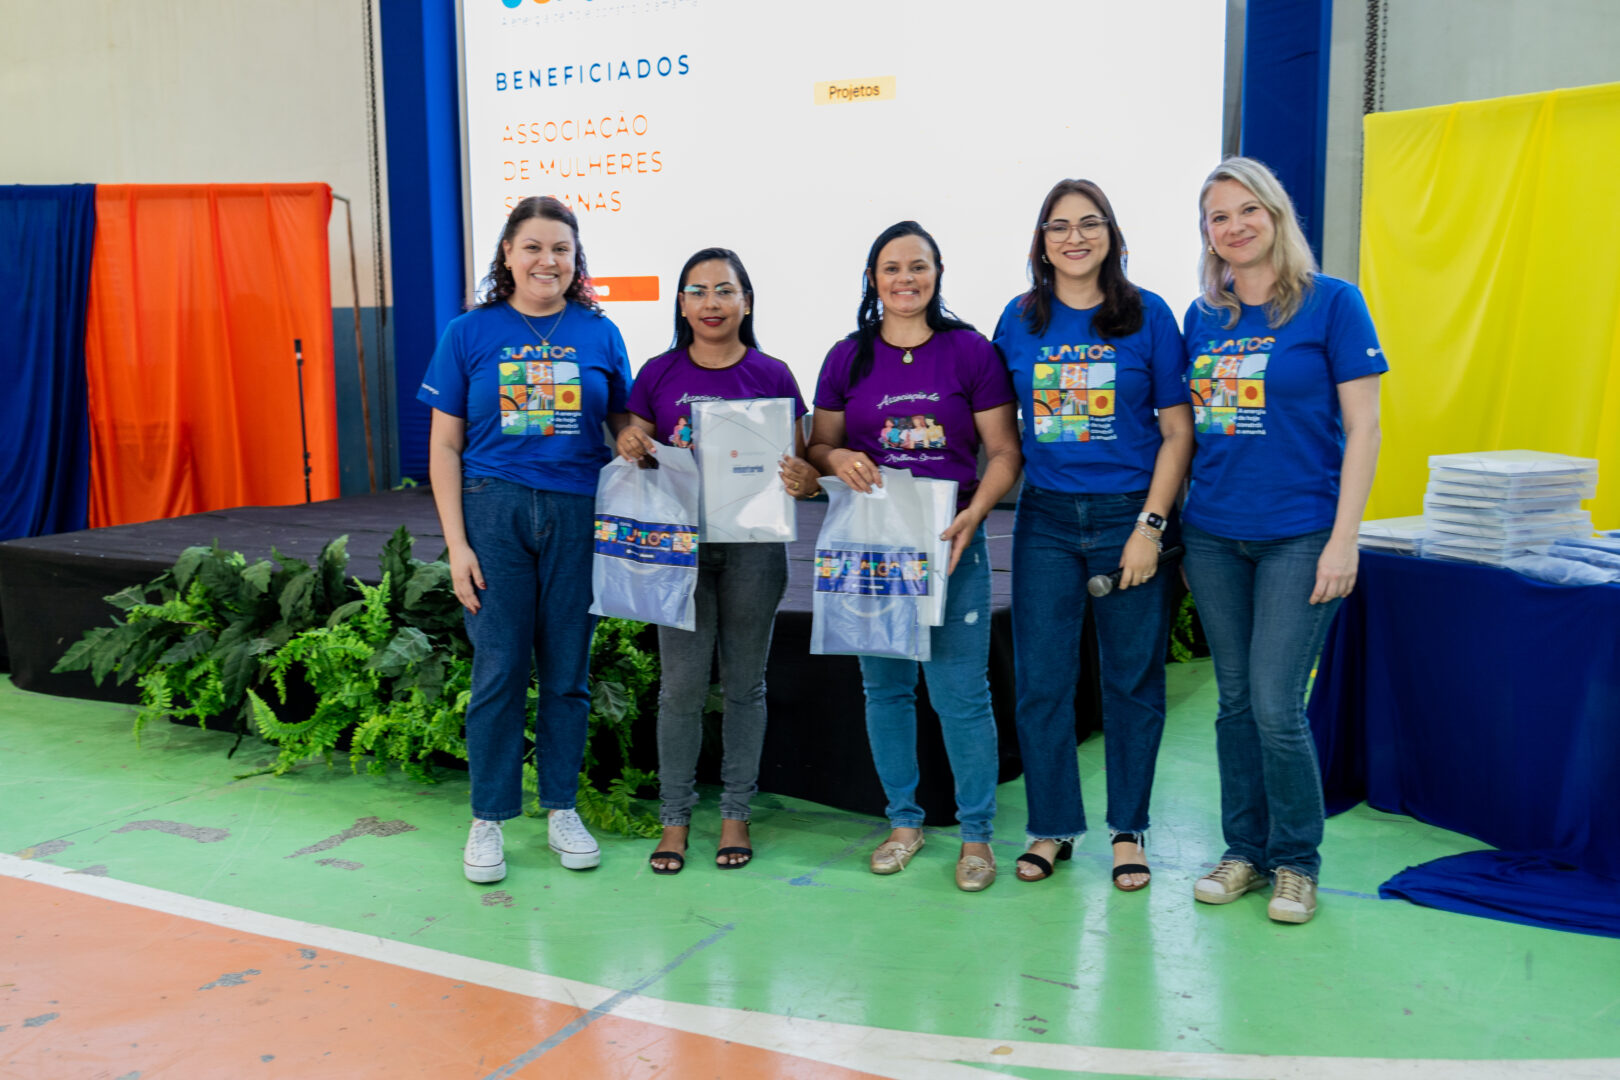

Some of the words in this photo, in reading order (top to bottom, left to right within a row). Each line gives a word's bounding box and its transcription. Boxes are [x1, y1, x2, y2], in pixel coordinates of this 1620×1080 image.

[496, 54, 690, 92] BENEFICIADOS
[828, 84, 881, 101] Projetos
[503, 159, 531, 181] DE
[539, 150, 664, 179] MULHERES
[503, 190, 623, 217] SANAS
[499, 344, 577, 360] JUNTOS
[1036, 343, 1117, 361] JUNTOS
[1201, 336, 1277, 353] JUNTOS
[617, 525, 672, 548] JUNTOS
